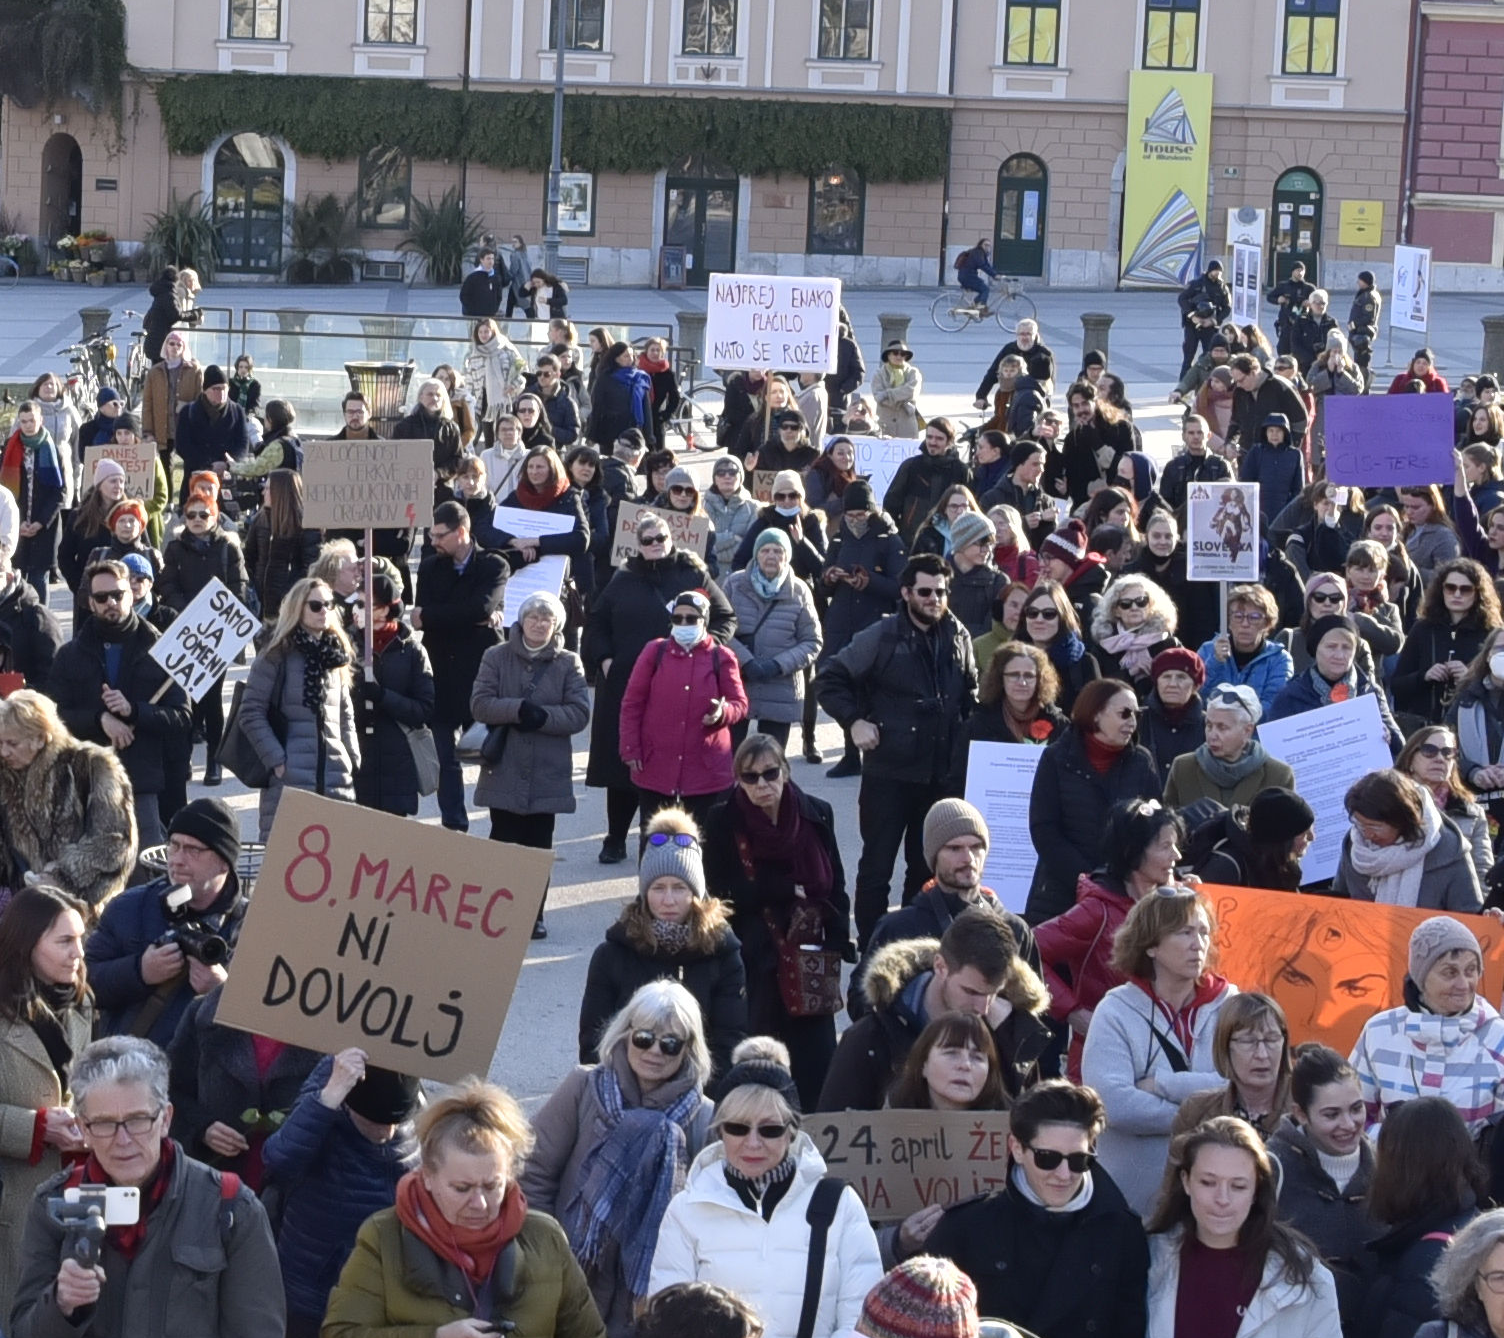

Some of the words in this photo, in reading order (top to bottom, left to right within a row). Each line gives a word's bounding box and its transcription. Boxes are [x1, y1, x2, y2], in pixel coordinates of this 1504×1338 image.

[792, 287, 833, 309] ENAKO
[752, 312, 803, 333] PLAČILO
[714, 341, 744, 360] NATO
[753, 339, 771, 361] ŠE
[197, 618, 224, 649] JA
[210, 590, 254, 638] SAMO
[165, 652, 207, 693] JA!
[176, 625, 228, 679] POMENI
[285, 824, 337, 908] 8.
[349, 852, 514, 938] MAREC
[822, 1125, 882, 1165] 24.
[892, 1127, 953, 1174] april
